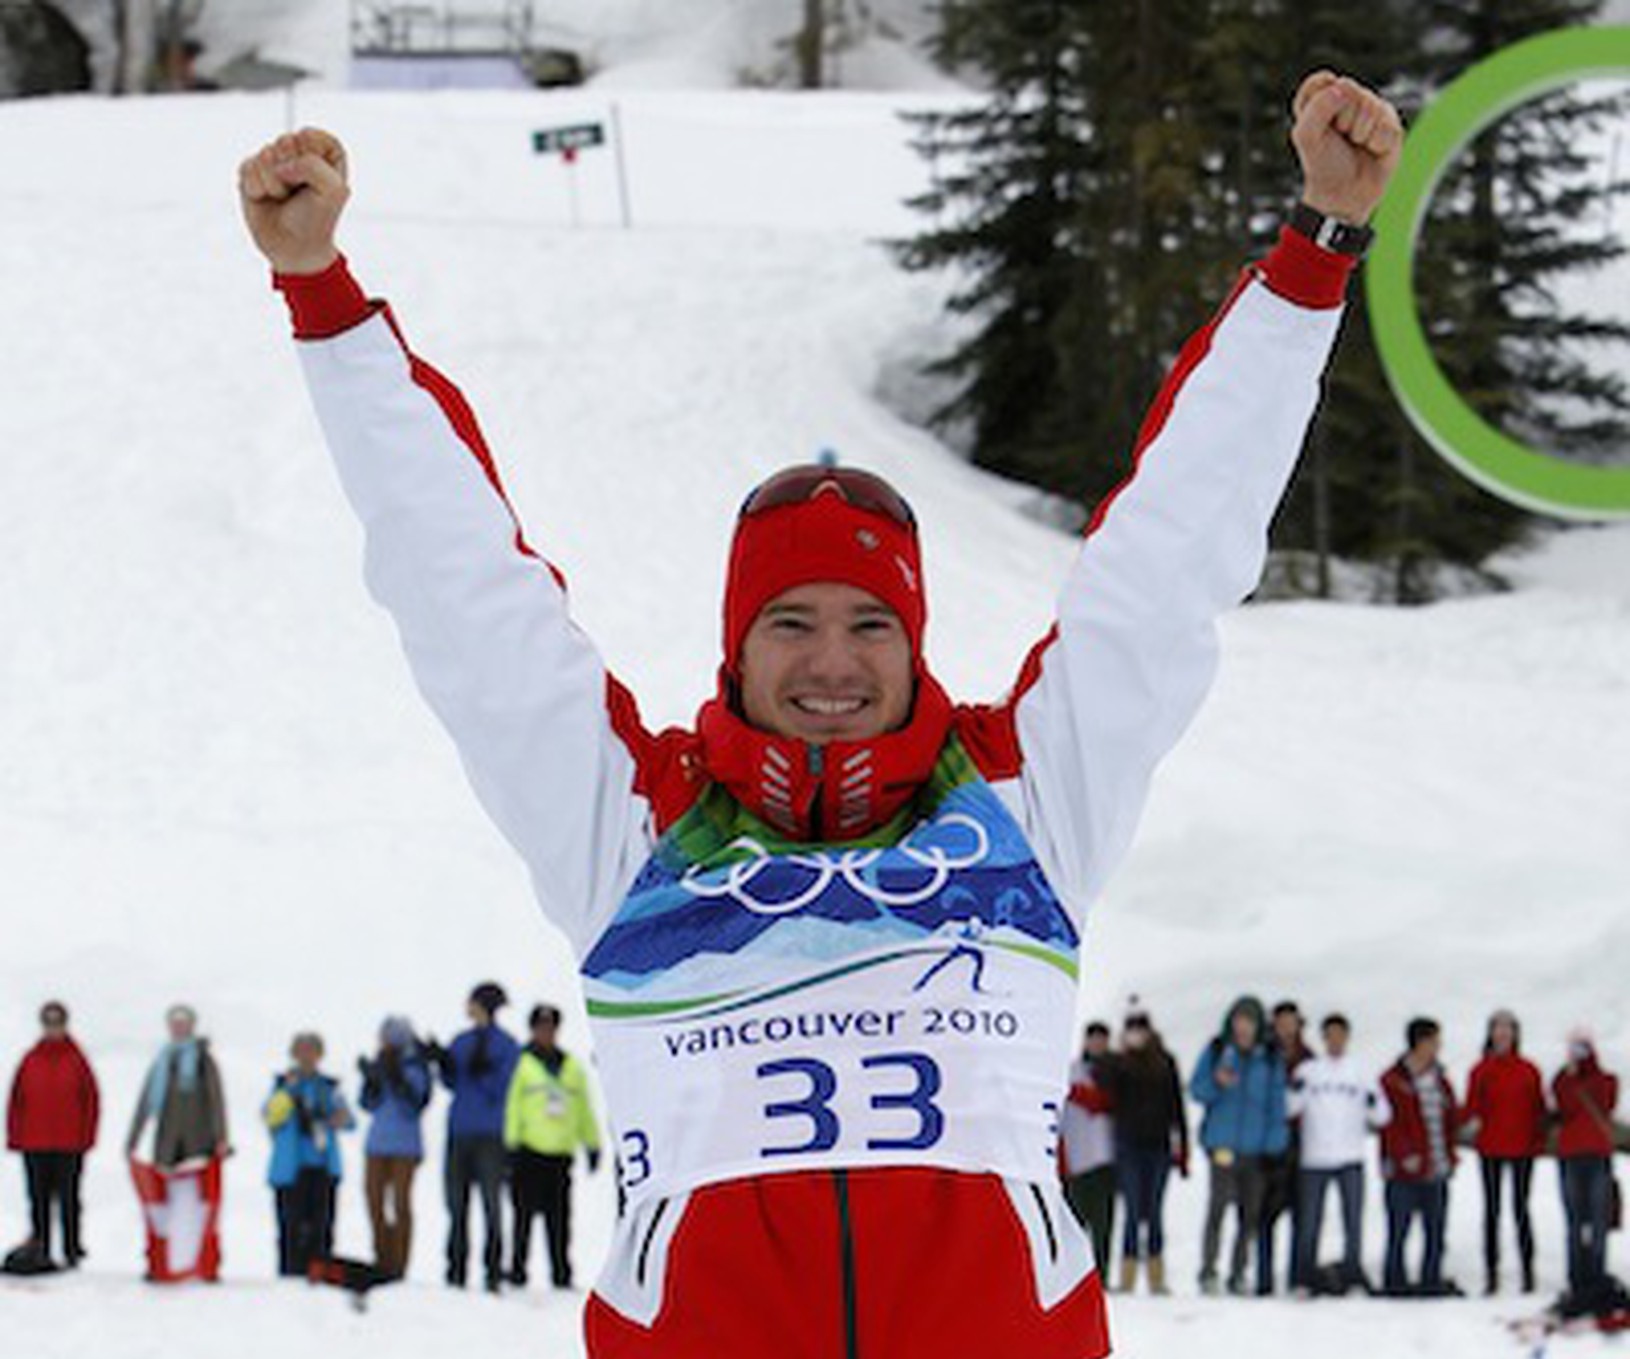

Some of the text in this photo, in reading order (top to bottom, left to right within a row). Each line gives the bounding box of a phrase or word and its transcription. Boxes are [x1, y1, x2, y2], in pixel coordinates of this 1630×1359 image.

[664, 1008, 1018, 1057] vancouver 2010
[756, 1052, 946, 1158] 33
